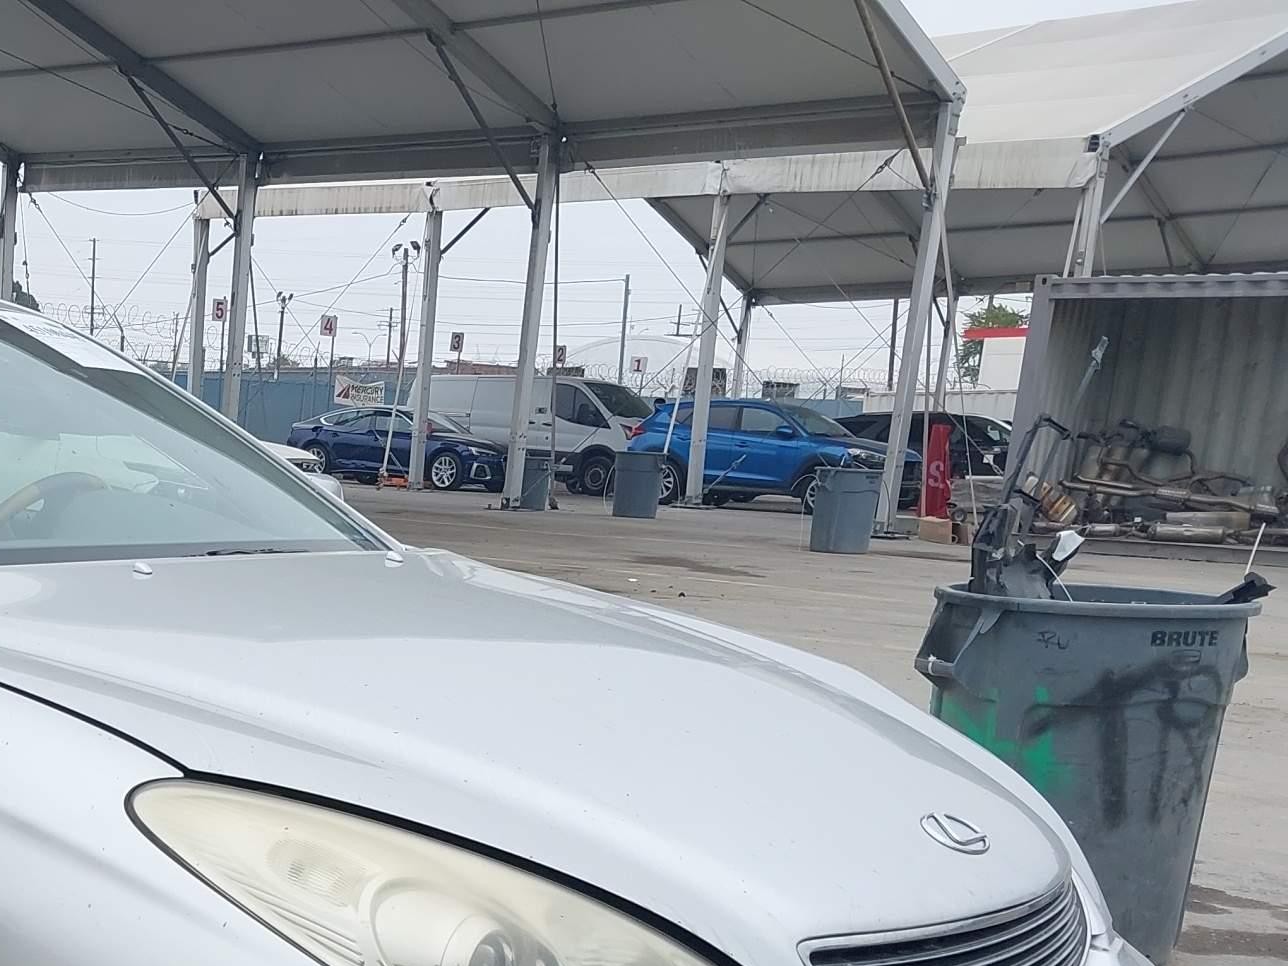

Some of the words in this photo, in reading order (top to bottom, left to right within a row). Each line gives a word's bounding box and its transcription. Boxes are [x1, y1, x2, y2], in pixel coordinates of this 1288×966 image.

[215, 301, 225, 319] 5
[323, 317, 334, 335] 4
[452, 334, 461, 350] 3
[557, 347, 564, 361] 2
[633, 358, 643, 373] 1
[351, 384, 384, 395] MERCURY
[1150, 630, 1220, 648] BRUTE
